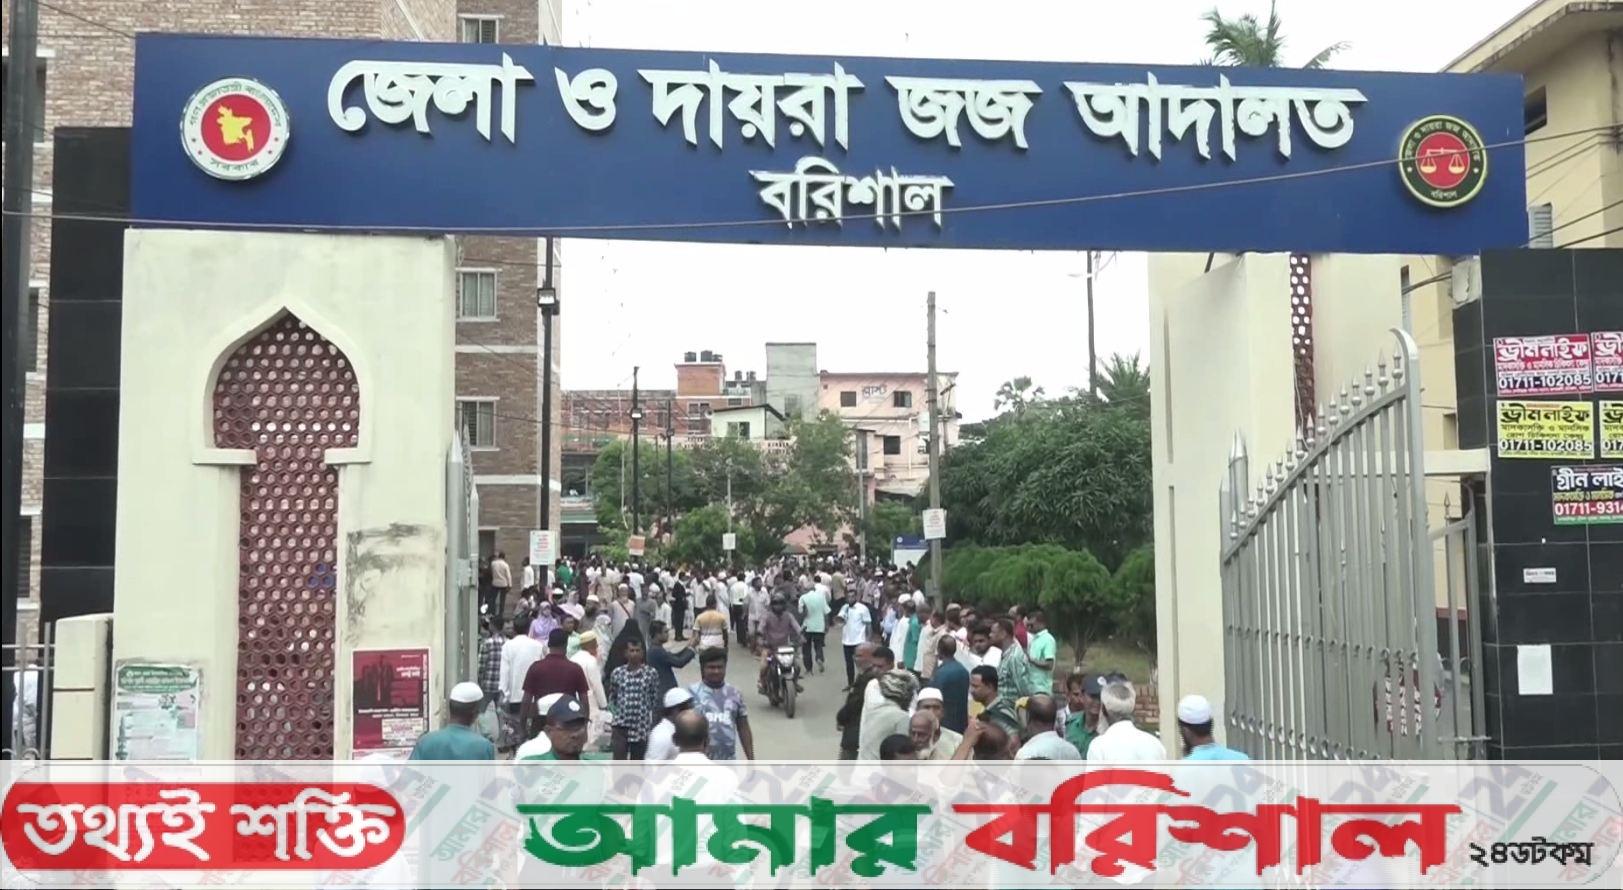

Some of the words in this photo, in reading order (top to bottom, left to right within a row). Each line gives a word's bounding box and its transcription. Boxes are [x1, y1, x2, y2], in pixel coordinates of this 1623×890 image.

[328, 53, 534, 144] জেলা
[555, 67, 617, 132] ও
[637, 58, 865, 150] দায়রা
[885, 76, 1043, 150] জজ
[1063, 72, 1368, 162] আদালত
[749, 156, 954, 229] বরিশাল
[1499, 374, 1592, 389] 01711-102085
[1499, 439, 1592, 451] 01711-102085
